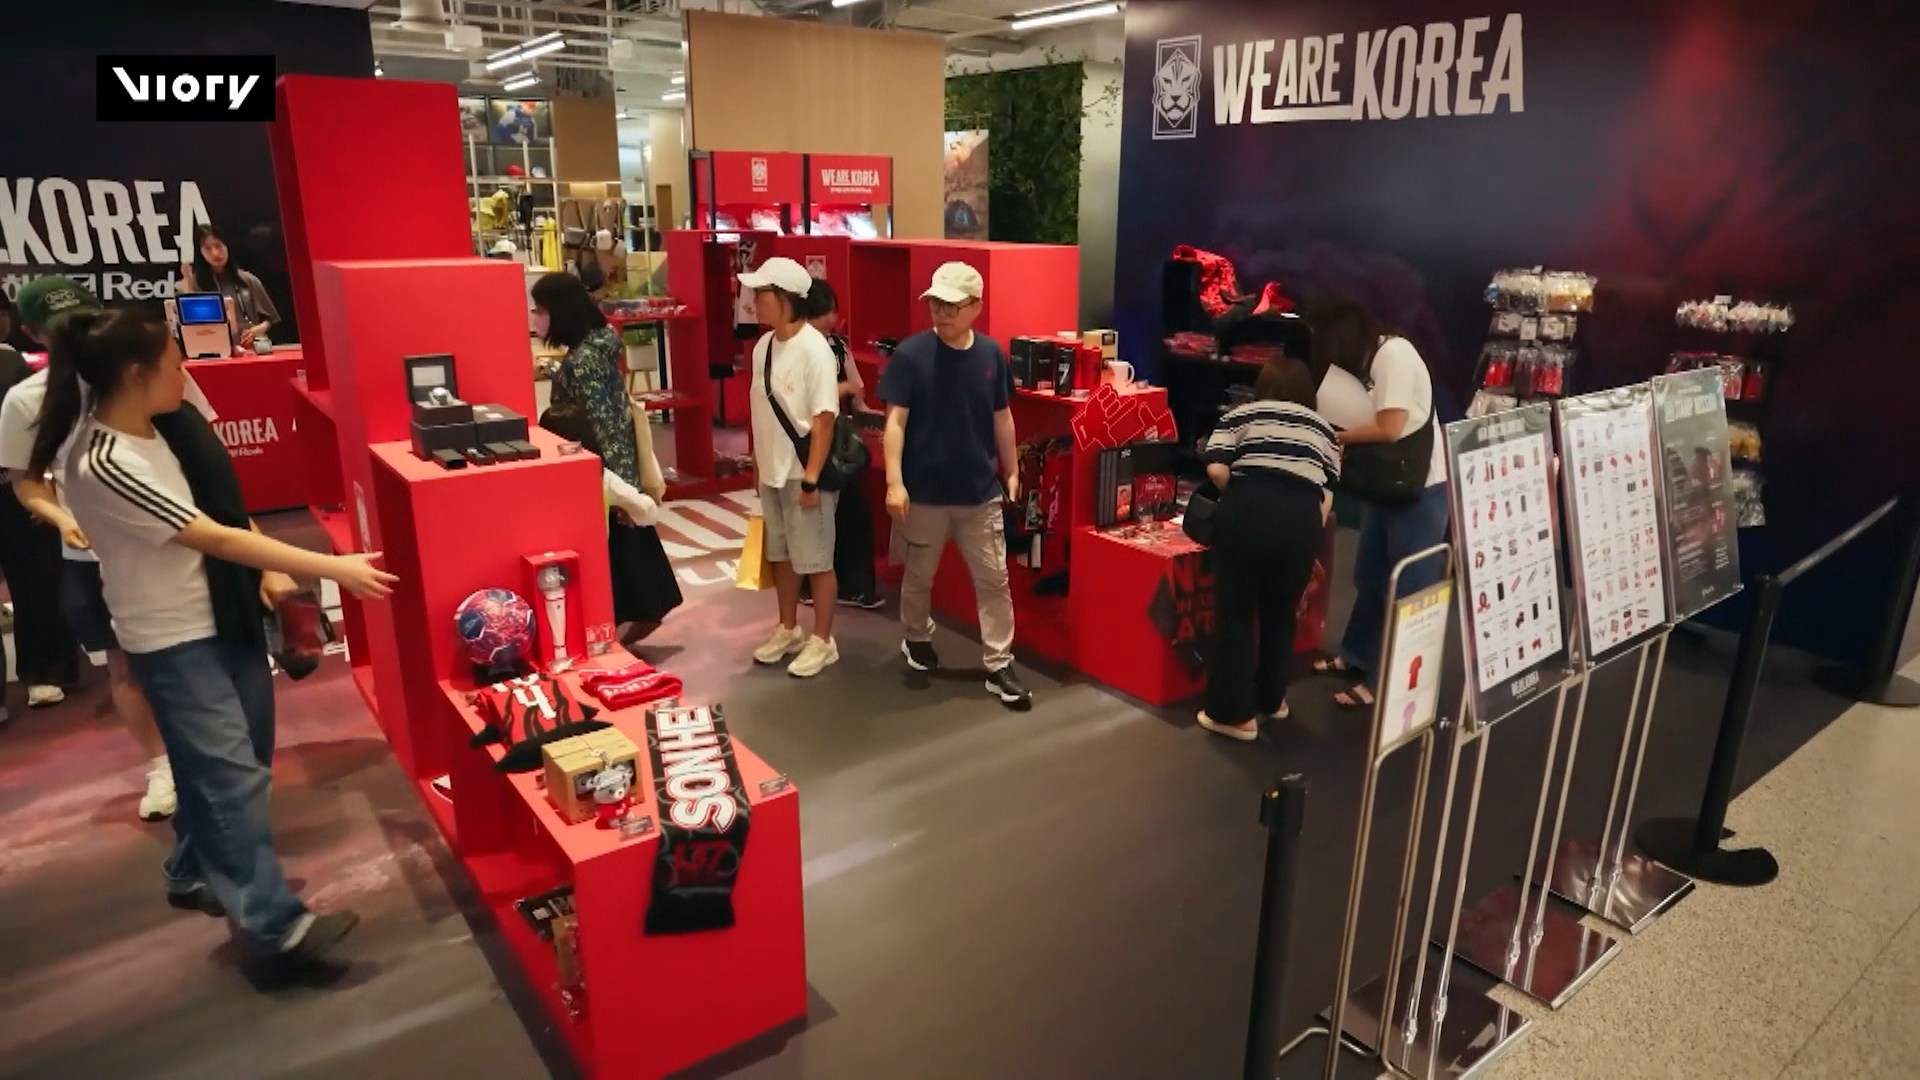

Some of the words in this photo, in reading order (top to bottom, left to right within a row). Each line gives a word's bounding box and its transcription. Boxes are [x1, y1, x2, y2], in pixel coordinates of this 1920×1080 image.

[1213, 39, 1276, 125] WE
[1274, 33, 1344, 106] ARE
[1351, 13, 1525, 121] KOREA
[0, 176, 212, 265] KOREA
[655, 704, 737, 834] SONHE
